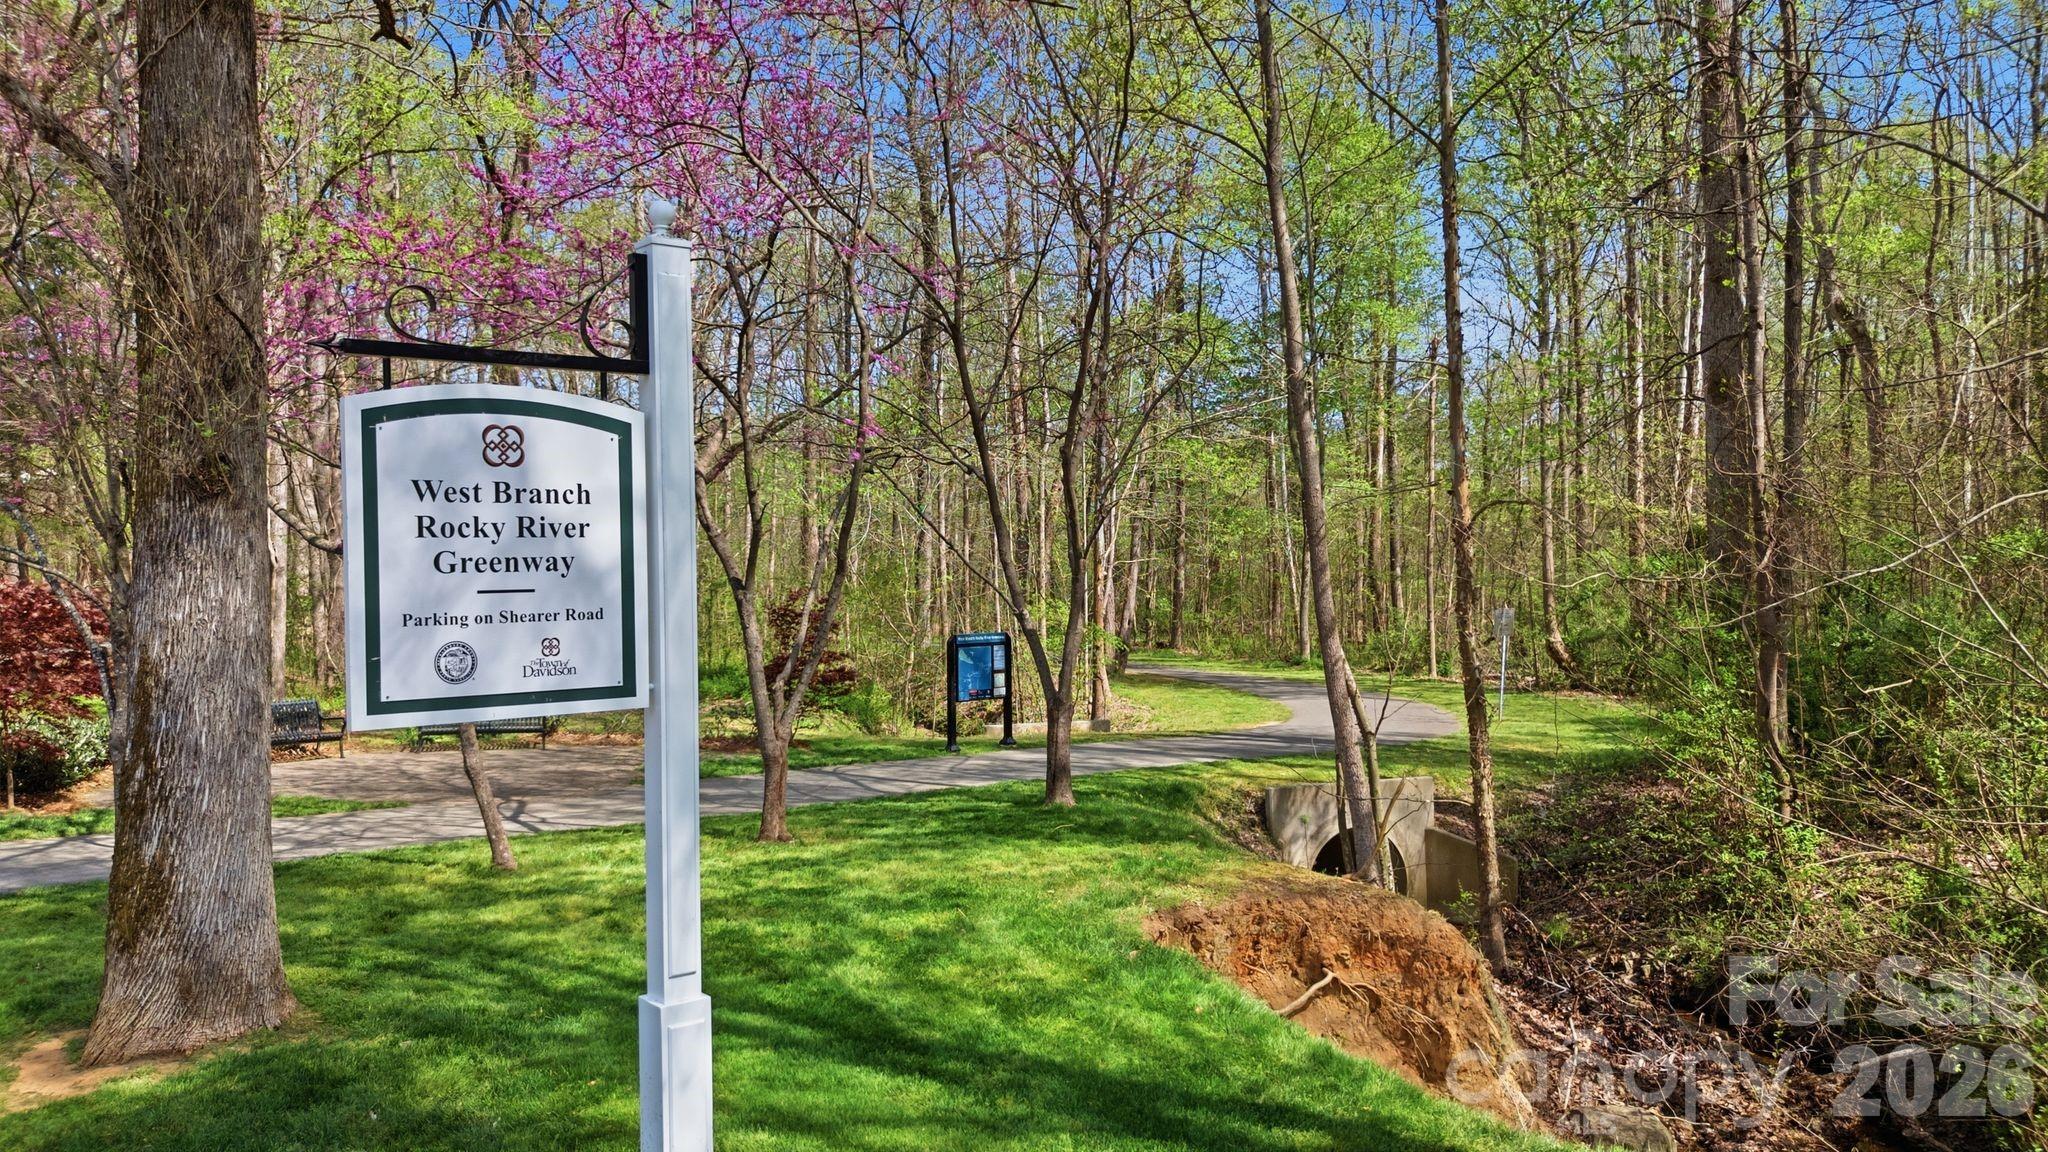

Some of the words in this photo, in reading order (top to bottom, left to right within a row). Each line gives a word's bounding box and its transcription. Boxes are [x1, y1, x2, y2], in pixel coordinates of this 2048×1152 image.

[411, 480, 482, 504] West
[493, 481, 592, 505] Branch
[415, 515, 506, 545] Rocky
[516, 515, 591, 539] River
[433, 550, 575, 578] Greenway
[402, 612, 469, 629] Parking
[474, 614, 493, 625] on
[499, 610, 561, 624] Shearer
[565, 607, 604, 621] Road
[523, 664, 577, 678] Davidson
[536, 658, 563, 668] Town
